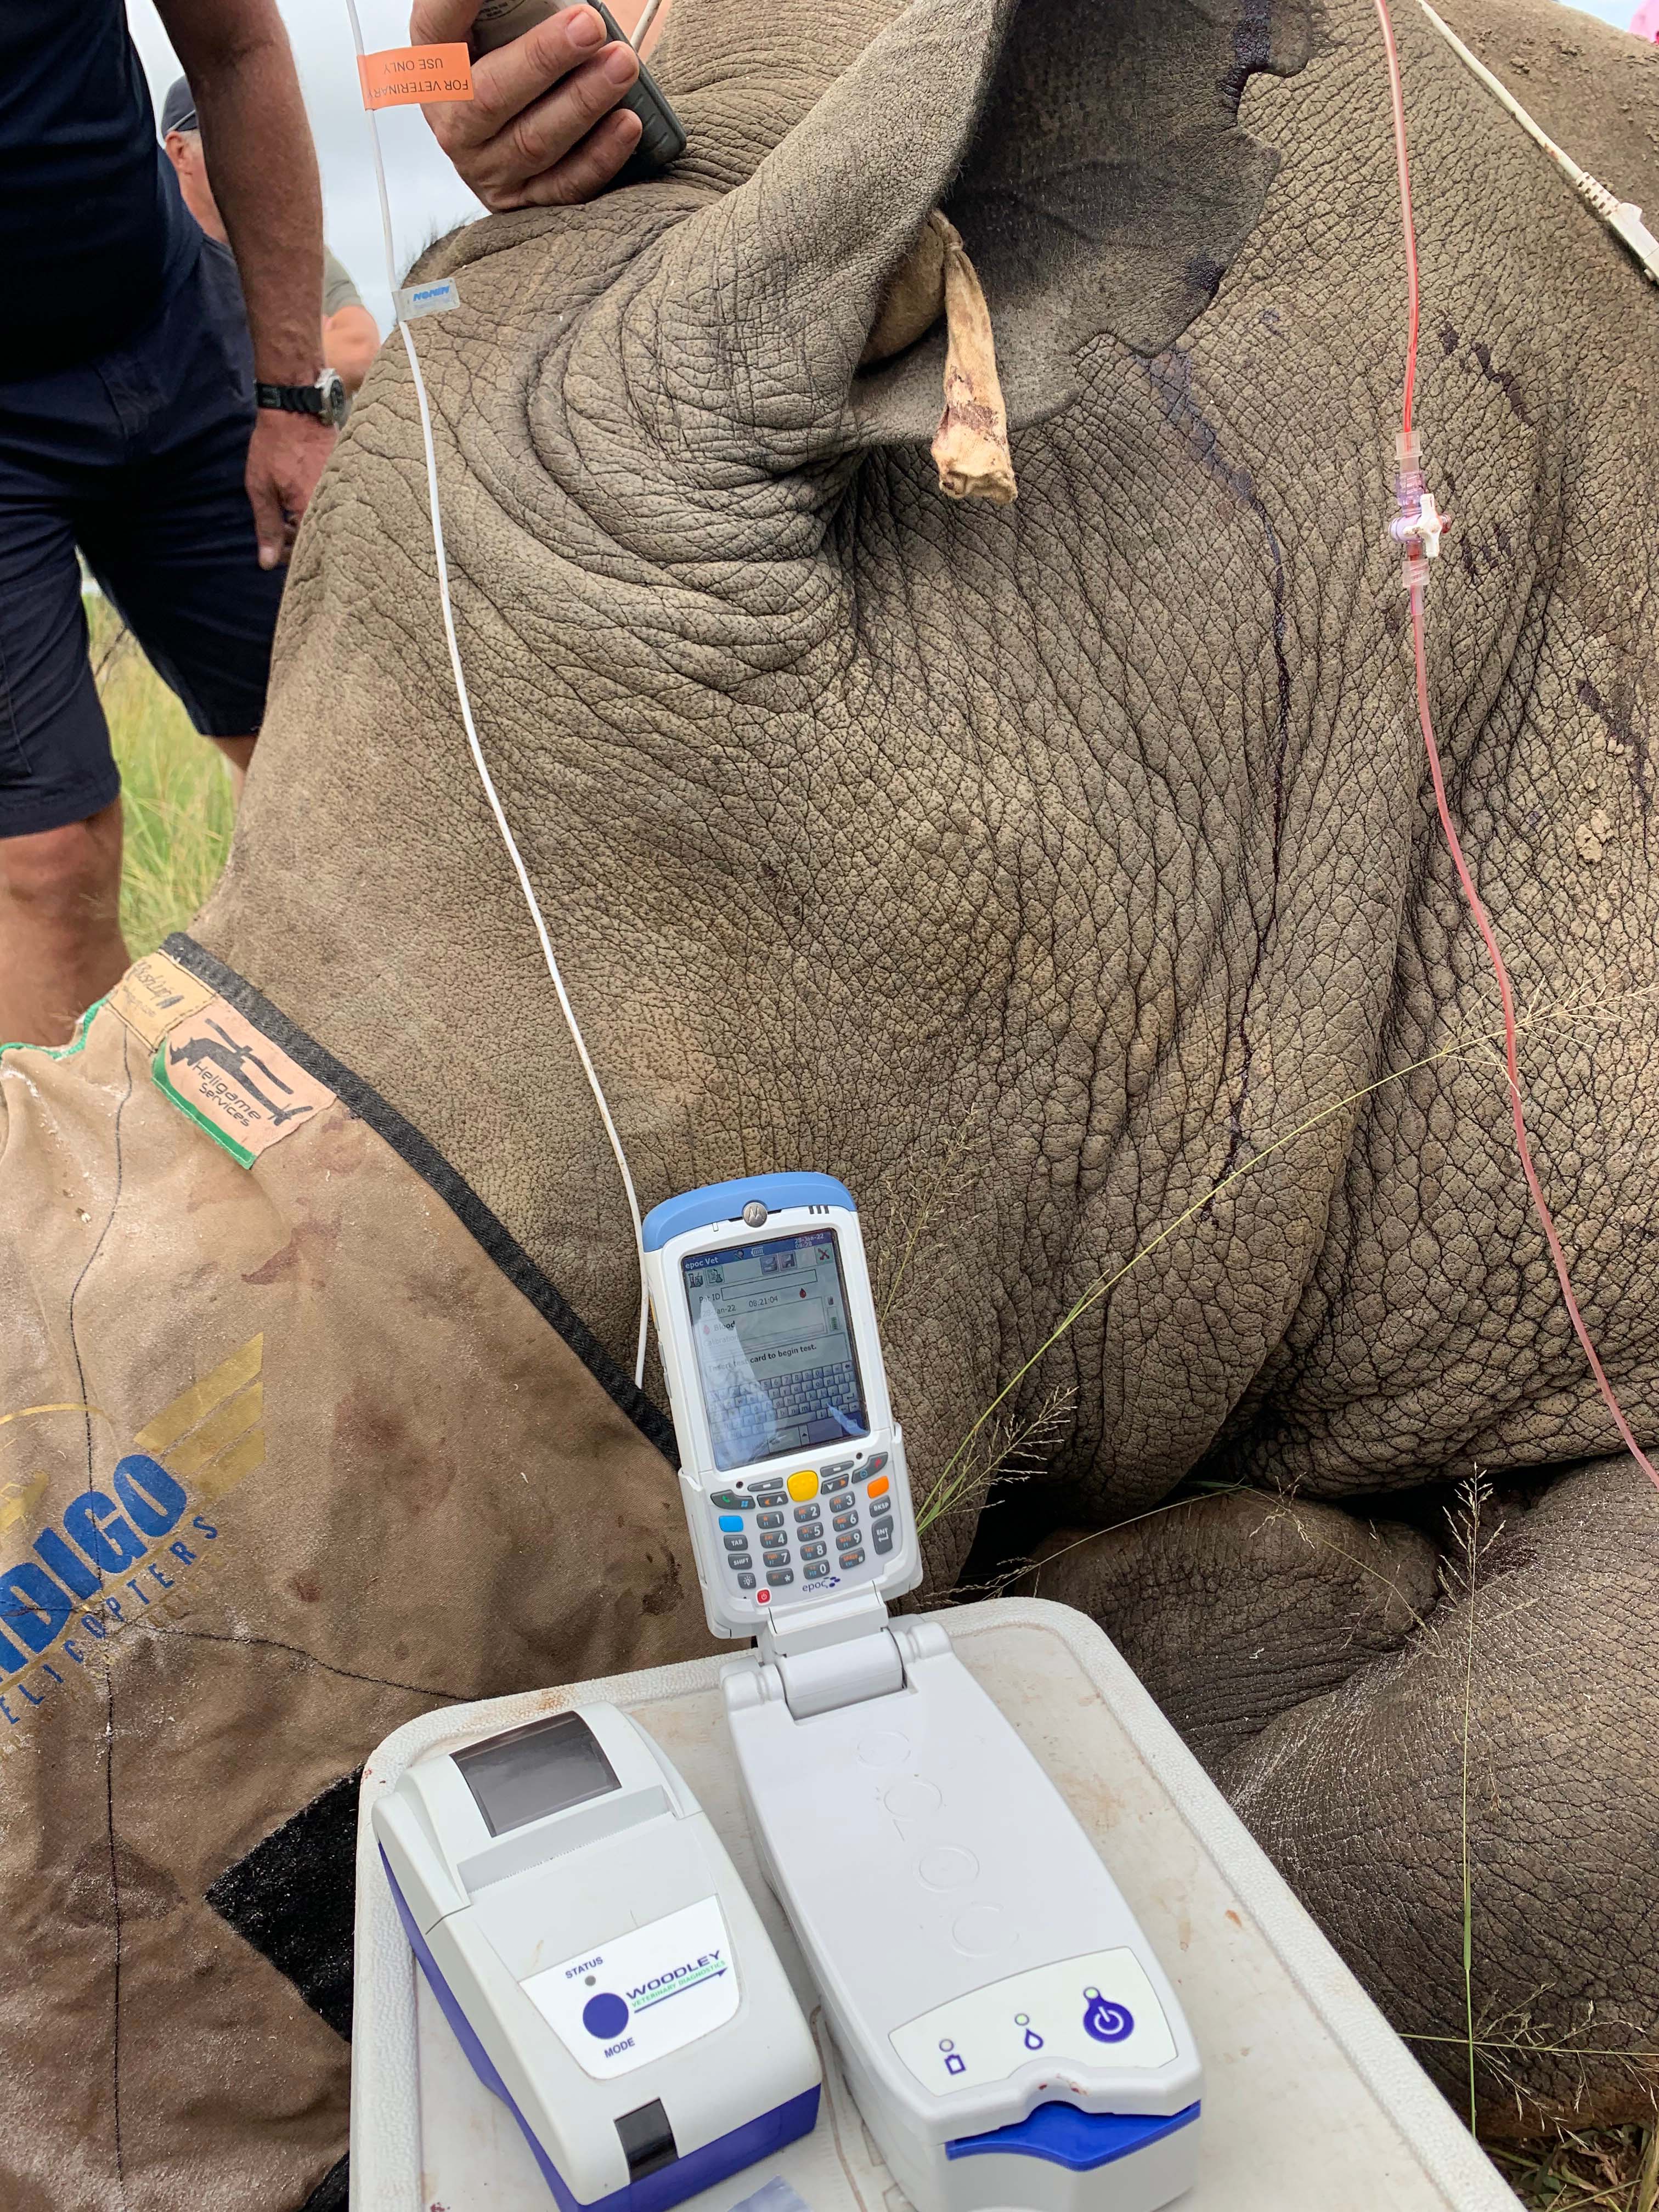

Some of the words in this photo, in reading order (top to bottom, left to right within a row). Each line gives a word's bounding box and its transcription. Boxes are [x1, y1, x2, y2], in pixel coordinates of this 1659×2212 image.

[384, 60, 414, 74] ONLY
[419, 58, 443, 70] USE
[368, 81, 442, 98] VETERINARY
[444, 80, 468, 91] FOR
[193, 1061, 261, 1119] Heligame
[199, 1082, 250, 1126] Services
[794, 1233, 824, 1244] 28-Jan-22
[685, 1261, 703, 1269] epoc
[699, 1295, 710, 1304] Pat
[715, 1320, 735, 1331] Blood
[751, 1353, 766, 1363] card
[778, 1348, 798, 1357] begin
[800, 1344, 817, 1352] test.
[775, 1514, 780, 1523] 1
[810, 1506, 817, 1516] 2
[846, 1496, 853, 1505] 3
[873, 1502, 889, 1511] BKSP
[778, 1533, 785, 1543] 4
[814, 1526, 820, 1536] 5
[850, 1514, 856, 1524] 6
[781, 1553, 787, 1562] 7
[817, 1545, 823, 1555] 8
[854, 1533, 860, 1543] 9
[820, 1564, 826, 1574] 0
[803, 1580, 826, 1593] epoc
[565, 1956, 603, 1979] STATUS
[626, 1950, 719, 2000] WOODLEY
[632, 1983, 676, 2007] VETERINARY
[678, 1960, 726, 1985] DIAGNOSTICS
[604, 2037, 635, 2058] MODE
